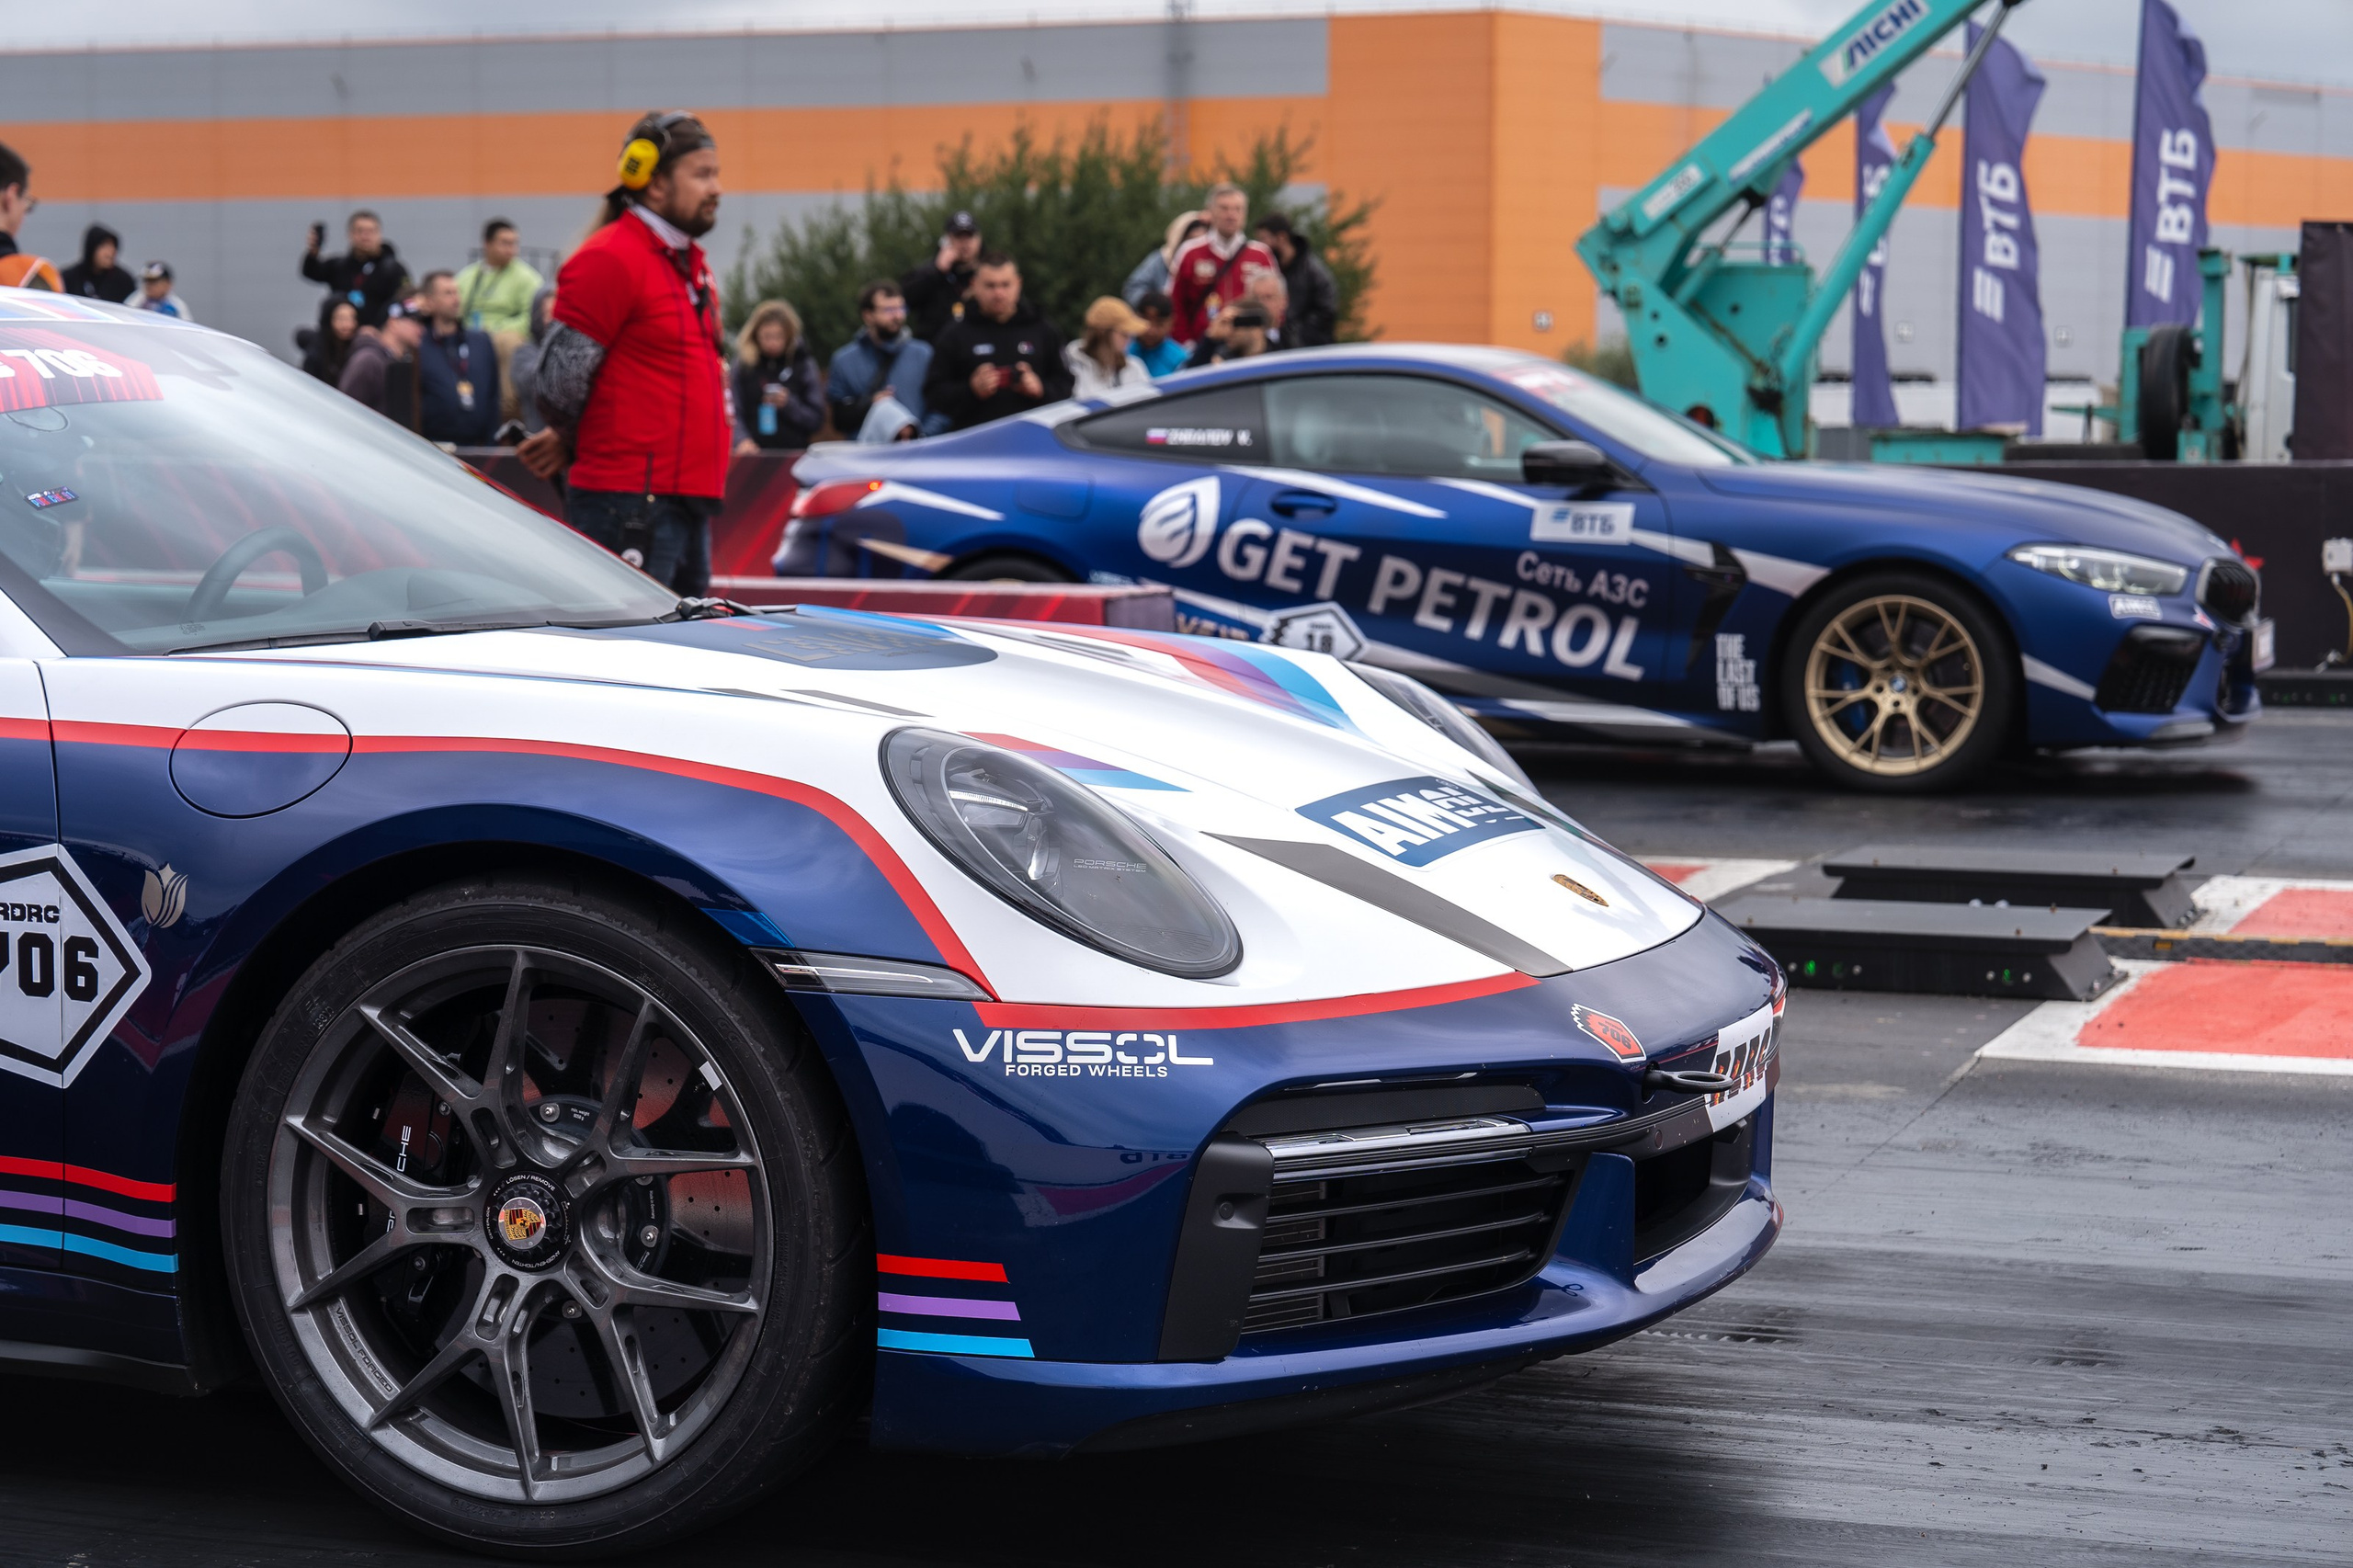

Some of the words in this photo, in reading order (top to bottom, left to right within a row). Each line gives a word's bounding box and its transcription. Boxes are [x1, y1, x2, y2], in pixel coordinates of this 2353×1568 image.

[1841, 0, 1921, 72] AICHI
[1570, 512, 1615, 535] ВТБ
[1516, 550, 1583, 594] Сеть
[1586, 569, 1650, 608] АЗС
[1216, 517, 1360, 599] GET
[1368, 553, 1646, 681] PETROL
[1715, 633, 1746, 658] THE
[1716, 659, 1756, 684] LAST
[1717, 684, 1735, 711] OF
[1736, 684, 1761, 712] US
[1074, 858, 1147, 869] PORSCHE
[0, 931, 99, 1003] 06
[952, 1028, 1214, 1065] VISSOL
[1597, 1020, 1632, 1050] 706
[1005, 1064, 1082, 1077] FORGED
[1087, 1064, 1169, 1078] WHEELS
[335, 1306, 358, 1349] VISSOL
[357, 1348, 393, 1392] FORGED
